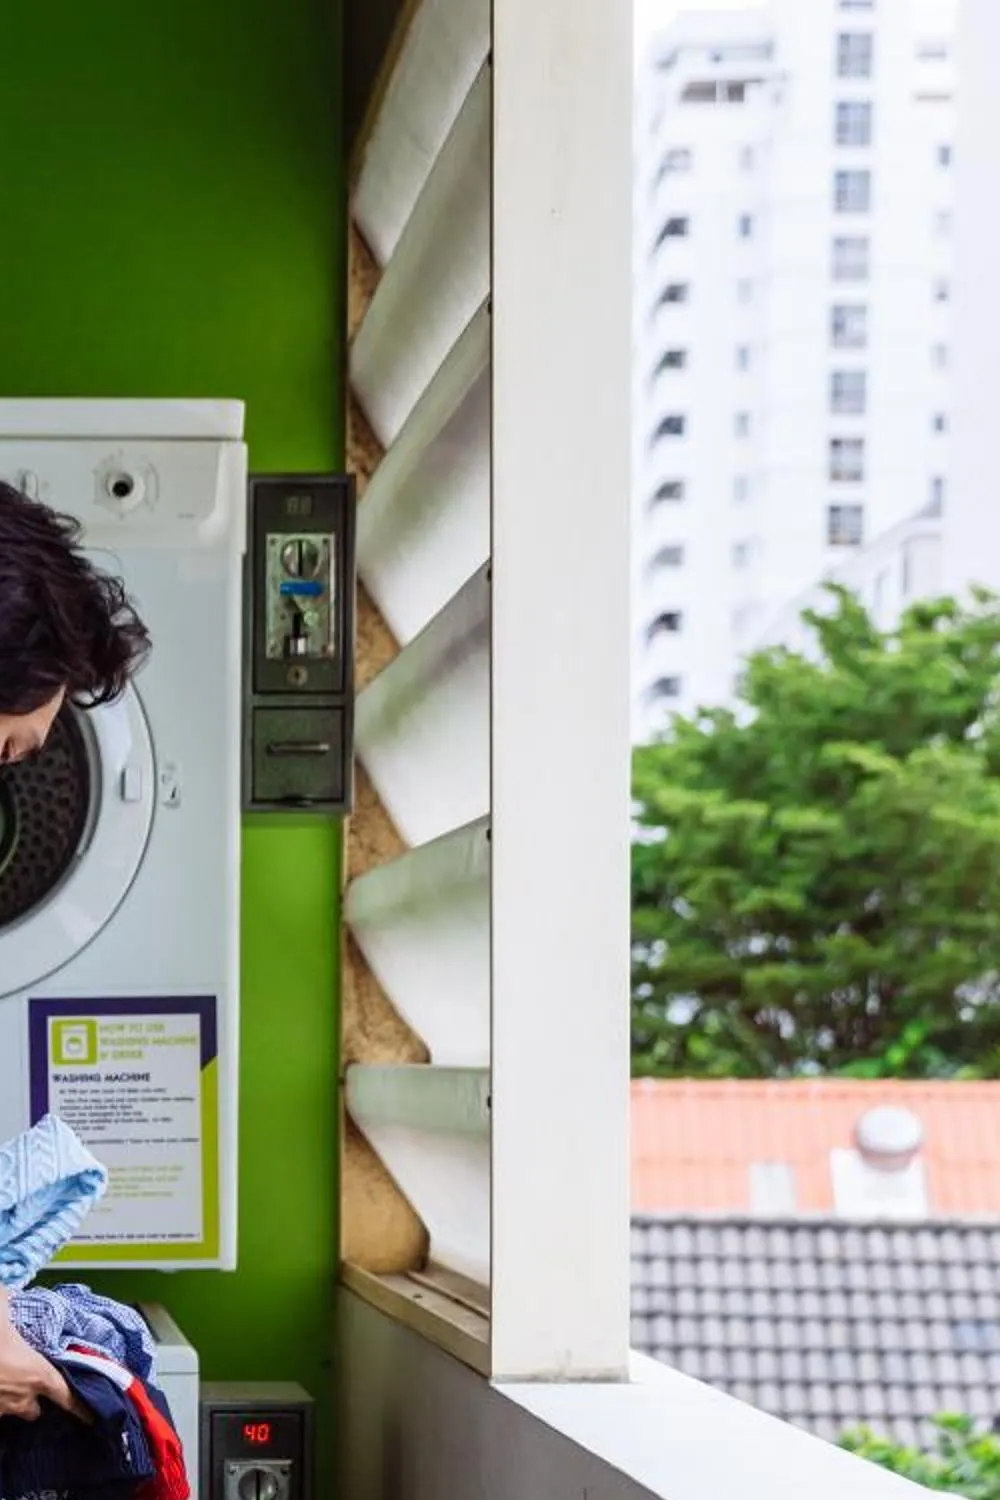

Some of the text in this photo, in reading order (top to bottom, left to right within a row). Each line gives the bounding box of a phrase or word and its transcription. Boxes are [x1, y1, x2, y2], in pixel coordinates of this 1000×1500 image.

[52, 1072, 151, 1083] WASHING MACHINE
[243, 1423, 271, 1442] 40
